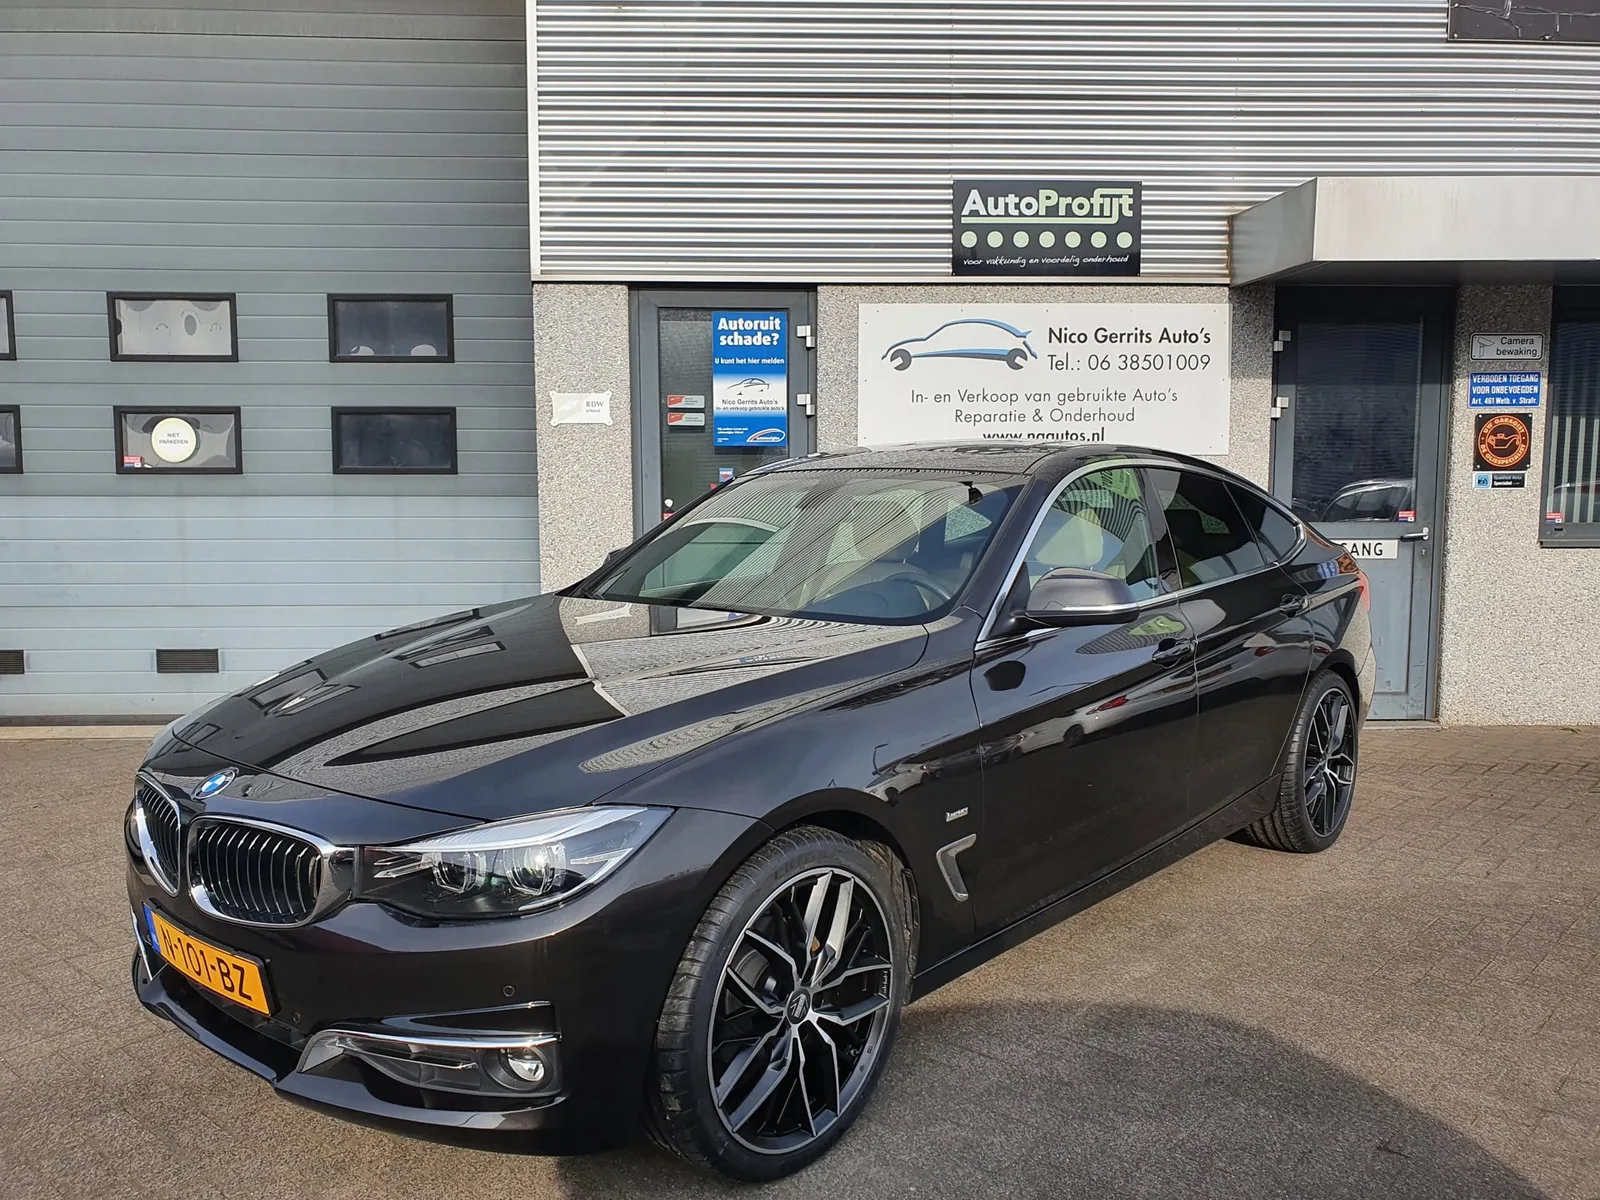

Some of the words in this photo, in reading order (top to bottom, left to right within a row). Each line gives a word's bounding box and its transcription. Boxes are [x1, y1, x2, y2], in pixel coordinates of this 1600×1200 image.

[961, 188, 1134, 224] AutoProfijt
[963, 258, 983, 266] voor
[986, 255, 1026, 267] vakkundig
[1041, 255, 1080, 267] voordelig
[1083, 254, 1130, 264] onderhoud
[718, 316, 781, 331] Autoruit
[719, 332, 780, 346] schade?
[1048, 327, 1087, 344] Nico
[1093, 327, 1153, 344] Gerrits
[1158, 327, 1212, 344] Auto's
[1500, 336, 1535, 345] Camera
[1496, 347, 1538, 358] bewaking
[720, 357, 735, 365] kunt
[736, 357, 747, 365] het
[747, 357, 760, 365] hier
[761, 357, 785, 365] melden
[1048, 353, 1081, 371] Tel.:
[1088, 353, 1111, 371] 06
[1118, 353, 1212, 371] 38501009
[1472, 374, 1507, 383] VERBODEN
[1509, 374, 1539, 383] TOEGANG
[911, 389, 929, 404] In-
[933, 392, 951, 404] en
[957, 388, 1018, 406] Verkoop
[1024, 391, 1051, 403] van
[1057, 387, 1127, 406] gebruikte
[1132, 388, 1179, 402] Auto's
[1472, 386, 1490, 394] VOOR
[1491, 385, 1538, 394] ONBEVOEGDEN
[1471, 397, 1483, 405] Art.
[1484, 397, 1494, 405] 461
[1495, 397, 1512, 405] Wetb.
[1519, 396, 1537, 404] Strafr.
[955, 409, 1026, 426] Reparatie
[1032, 409, 1044, 422] &
[1050, 407, 1136, 423] Onderhoud
[1483, 422, 1493, 433] UW
[1494, 417, 1525, 433] GARAGIST
[160, 924, 253, 1001] N-101-BZ
